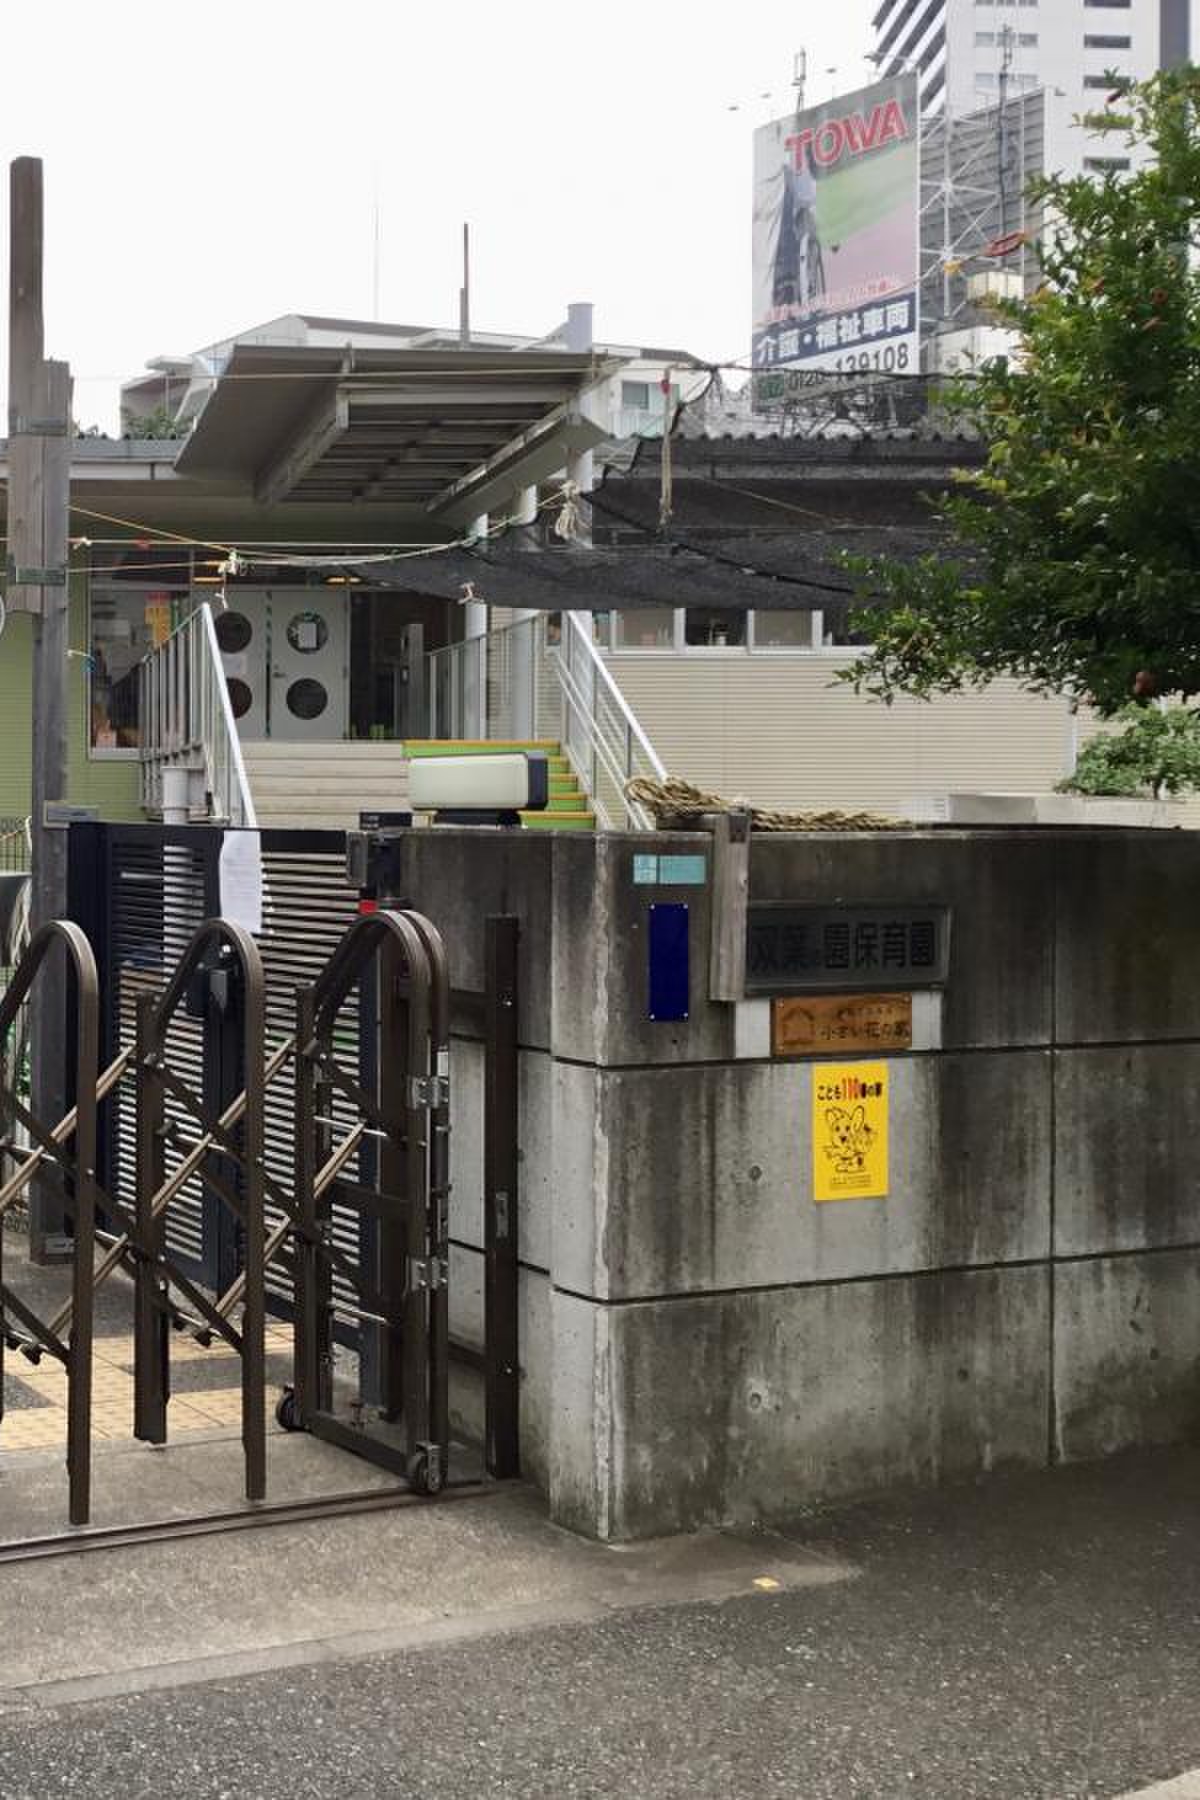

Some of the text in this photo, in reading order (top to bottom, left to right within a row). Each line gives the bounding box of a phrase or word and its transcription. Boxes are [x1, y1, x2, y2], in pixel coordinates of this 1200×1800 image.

[784, 98, 909, 174] TOWA
[756, 300, 911, 365] 介護・福祉車両
